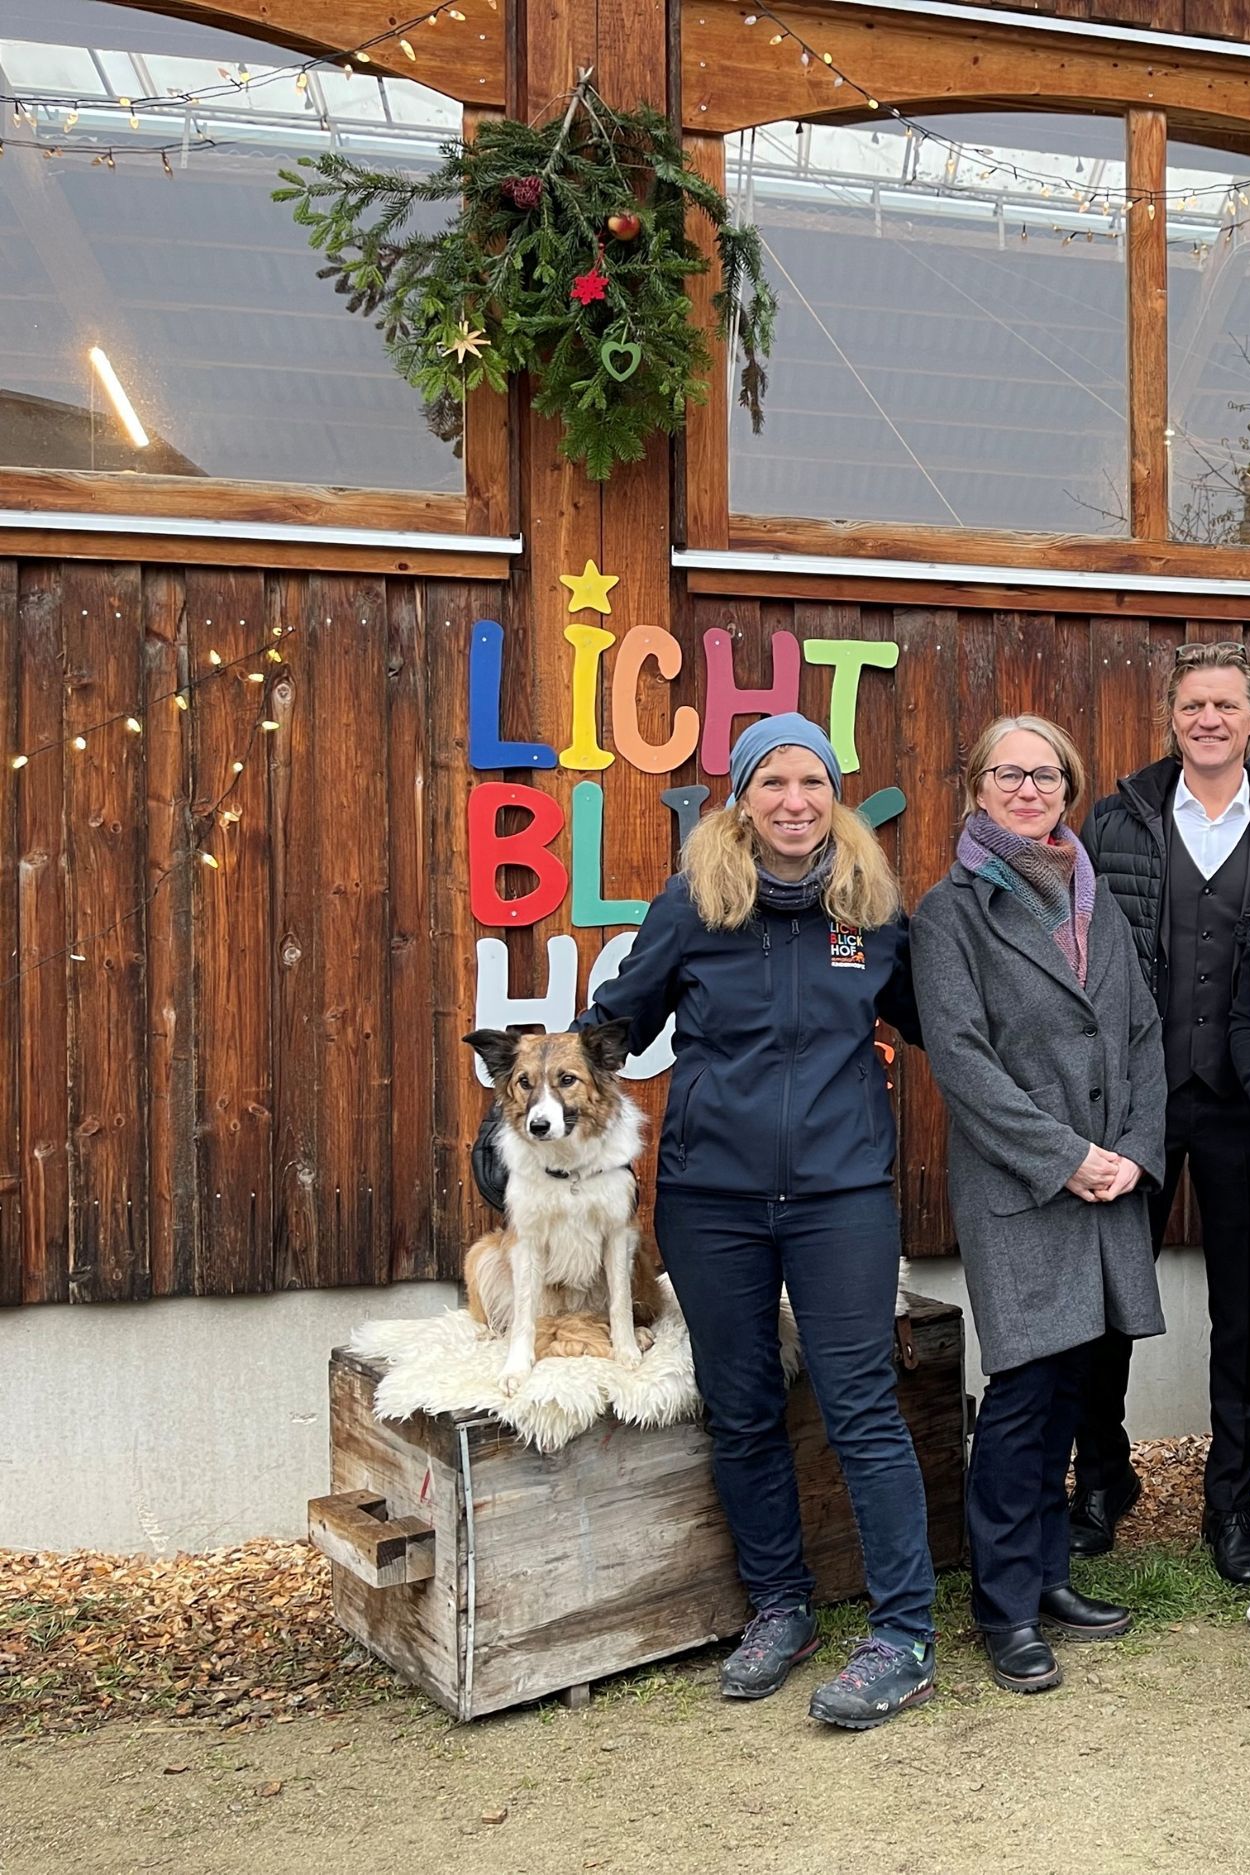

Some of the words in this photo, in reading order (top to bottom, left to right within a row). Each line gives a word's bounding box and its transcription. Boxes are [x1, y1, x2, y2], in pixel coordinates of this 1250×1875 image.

[469, 619, 900, 775] LICHT
[830, 933, 864, 947] BLICK
[831, 944, 857, 956] HOF
